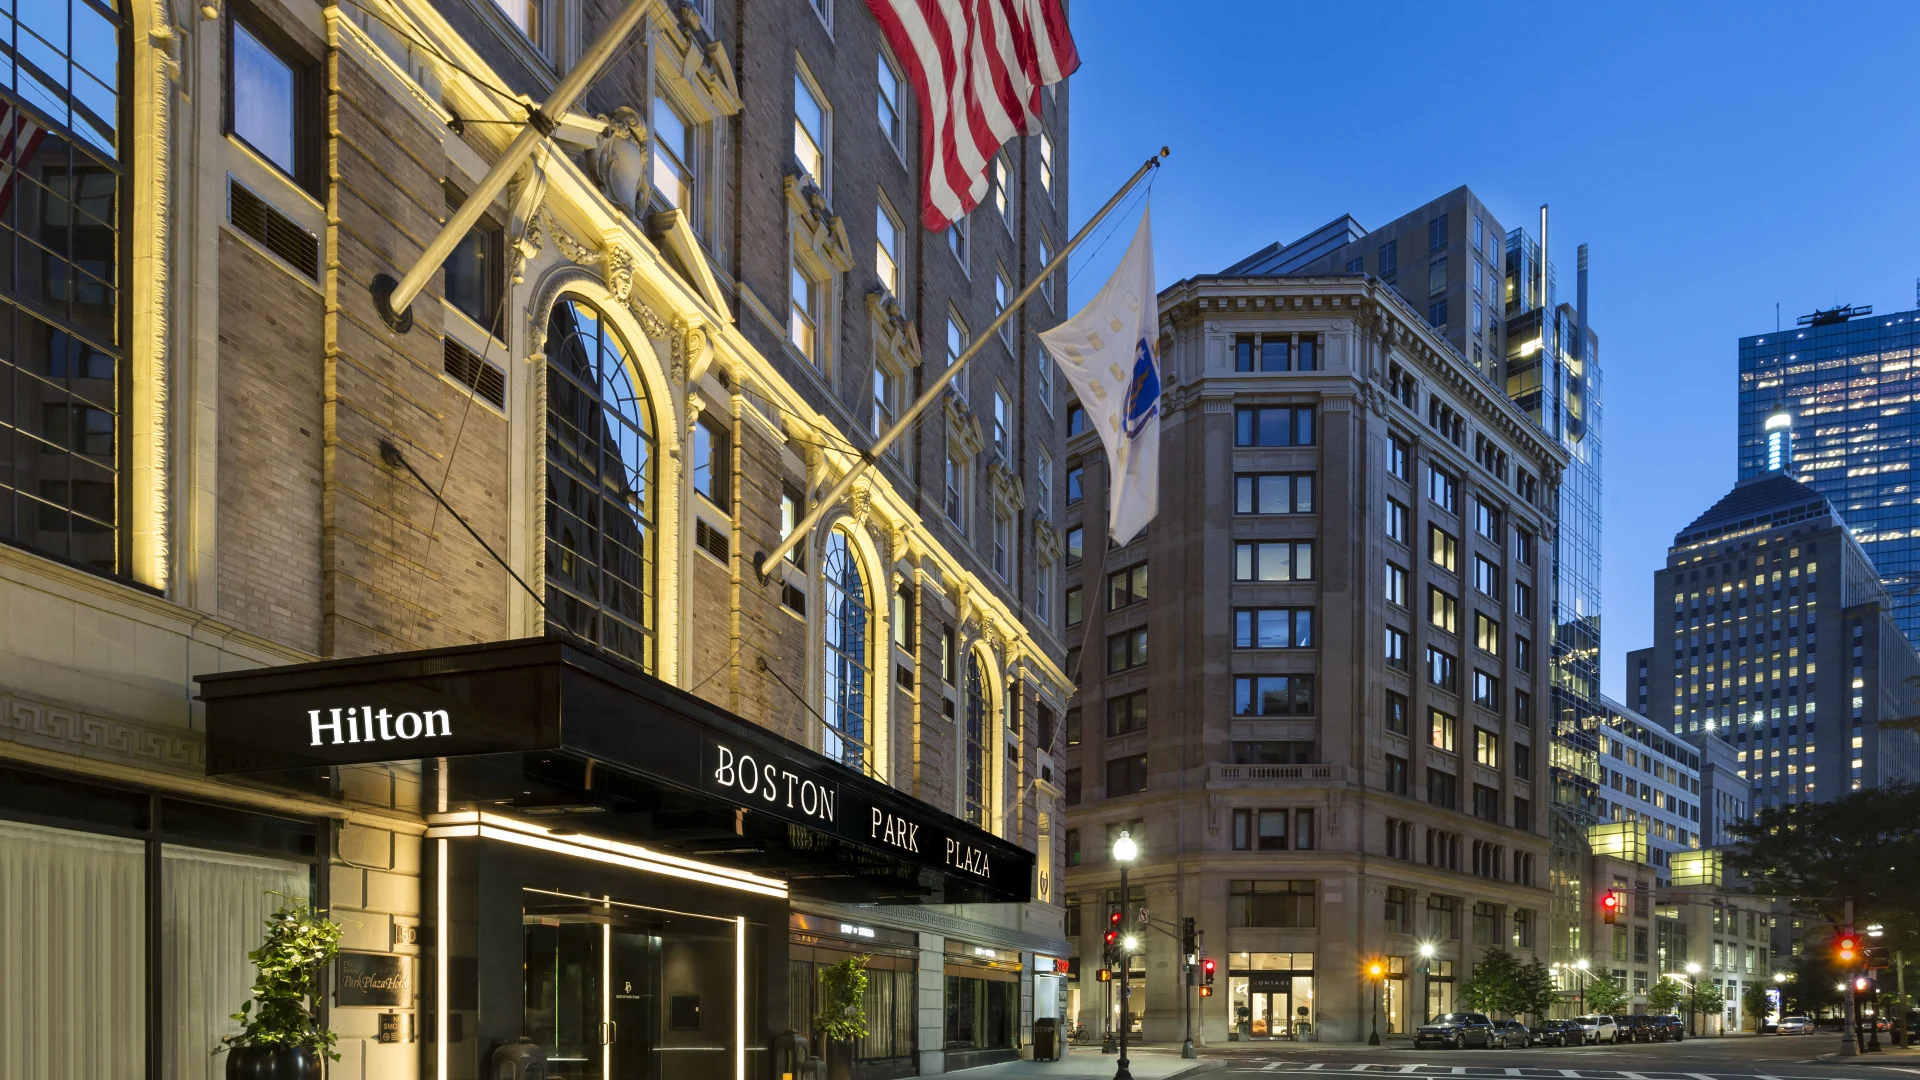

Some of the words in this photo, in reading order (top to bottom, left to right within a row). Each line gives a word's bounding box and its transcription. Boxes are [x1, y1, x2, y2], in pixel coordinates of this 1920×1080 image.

[308, 705, 453, 747] Hilton
[714, 744, 835, 823] BOSTON
[871, 806, 920, 854] PARK
[946, 837, 991, 879] PLAZA
[402, 928, 416, 941] 50
[342, 971, 366, 993] Park
[362, 972, 387, 988] Plaza
